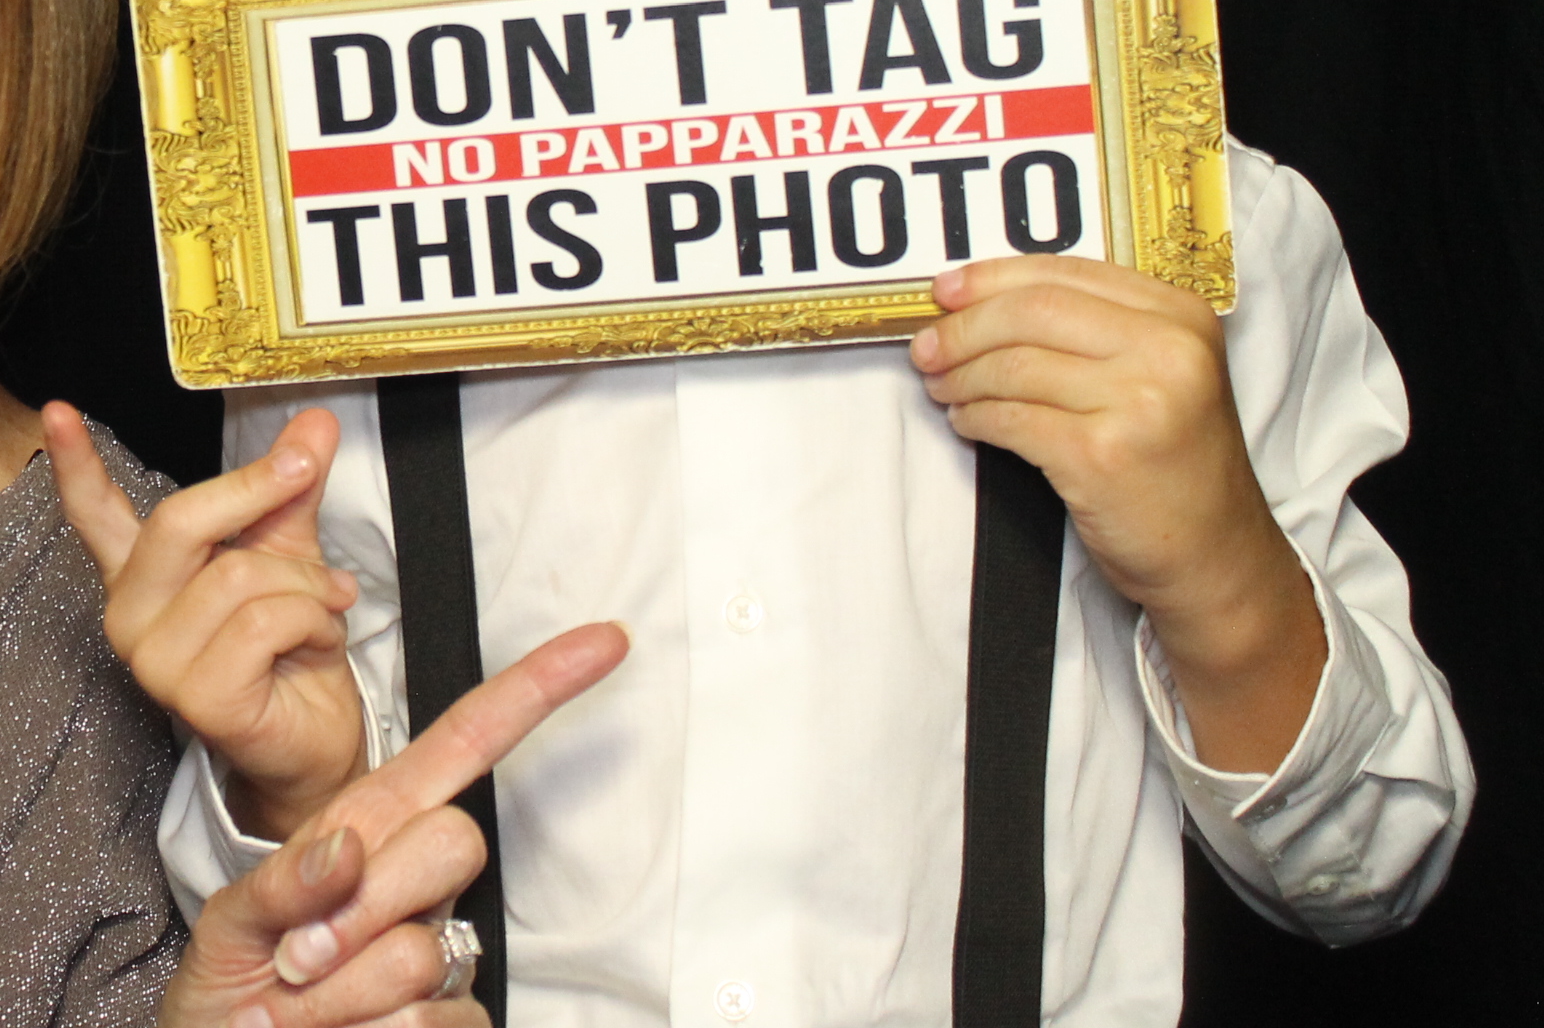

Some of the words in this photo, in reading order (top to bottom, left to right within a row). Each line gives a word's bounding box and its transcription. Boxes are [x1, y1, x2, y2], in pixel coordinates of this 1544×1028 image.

[309, 0, 726, 136] DON'T
[393, 131, 496, 187] NO
[520, 96, 1007, 179] PAPPARAZZI
[306, 188, 606, 307] THIS
[650, 149, 1084, 283] PHOTO
